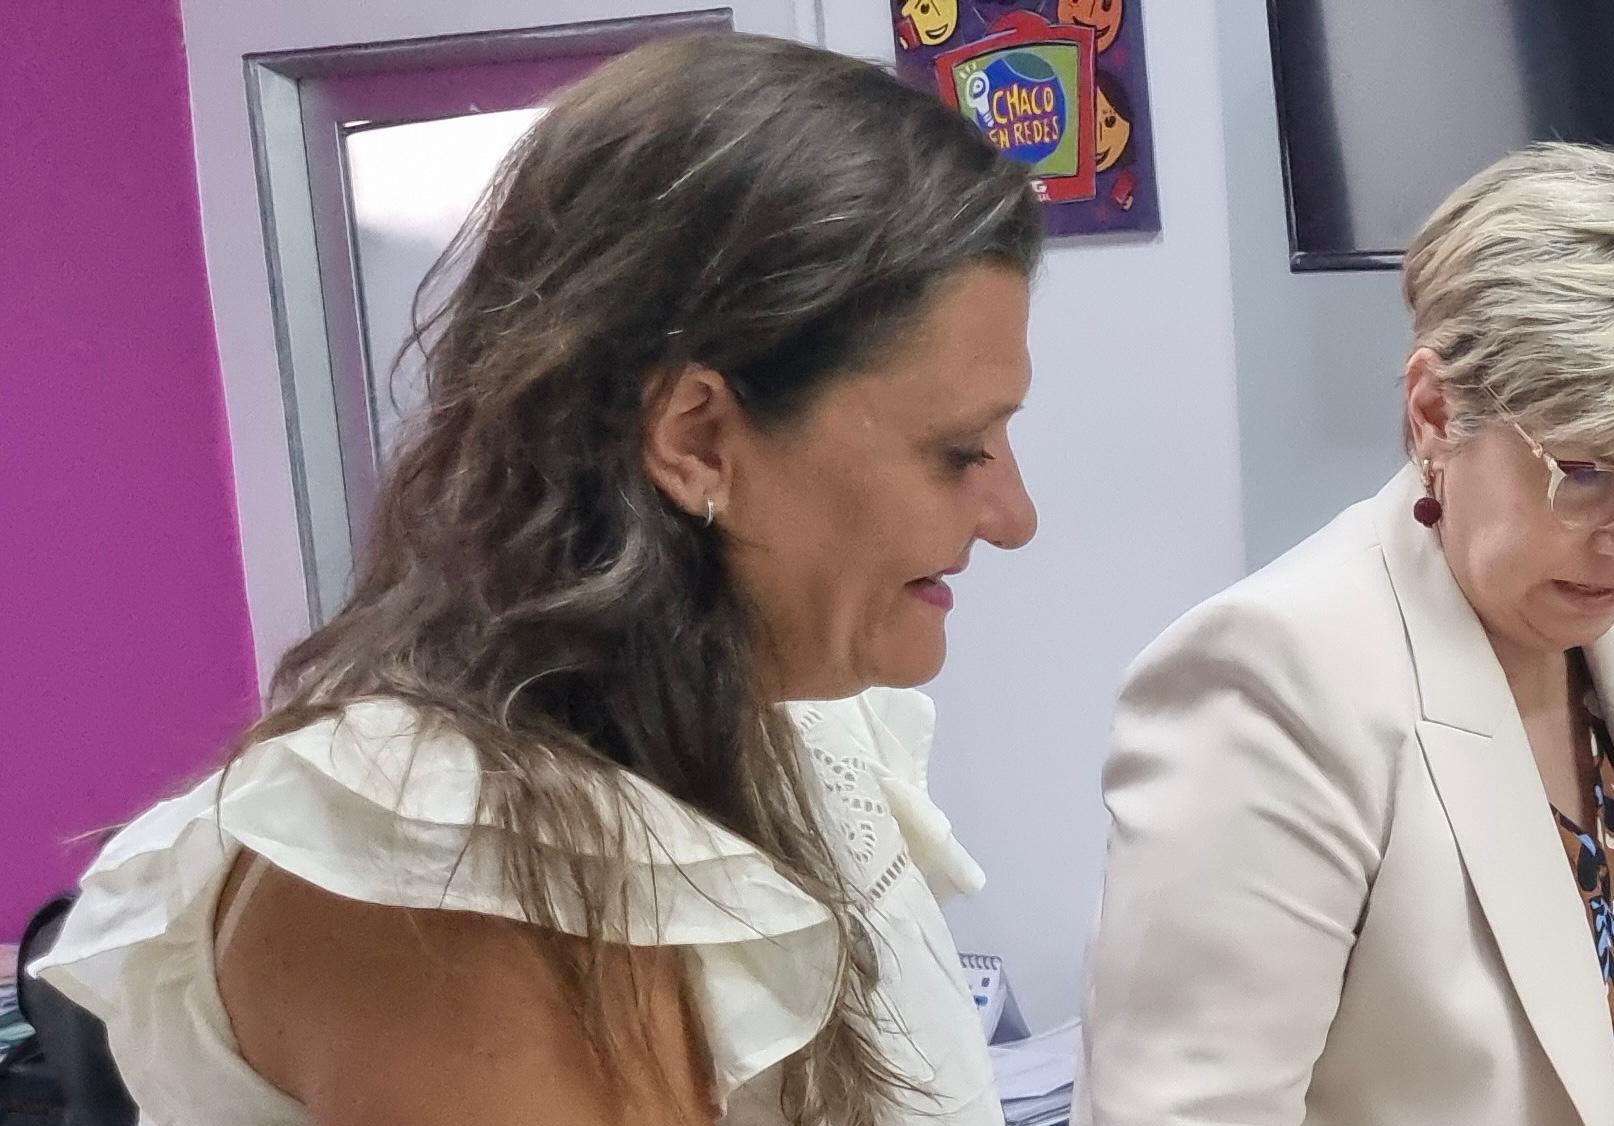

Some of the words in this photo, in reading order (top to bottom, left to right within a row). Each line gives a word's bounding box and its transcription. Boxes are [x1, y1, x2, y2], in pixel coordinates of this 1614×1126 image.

[993, 83, 1053, 124] CHACO
[989, 129, 1010, 149] EN
[1014, 116, 1058, 145] REDES
